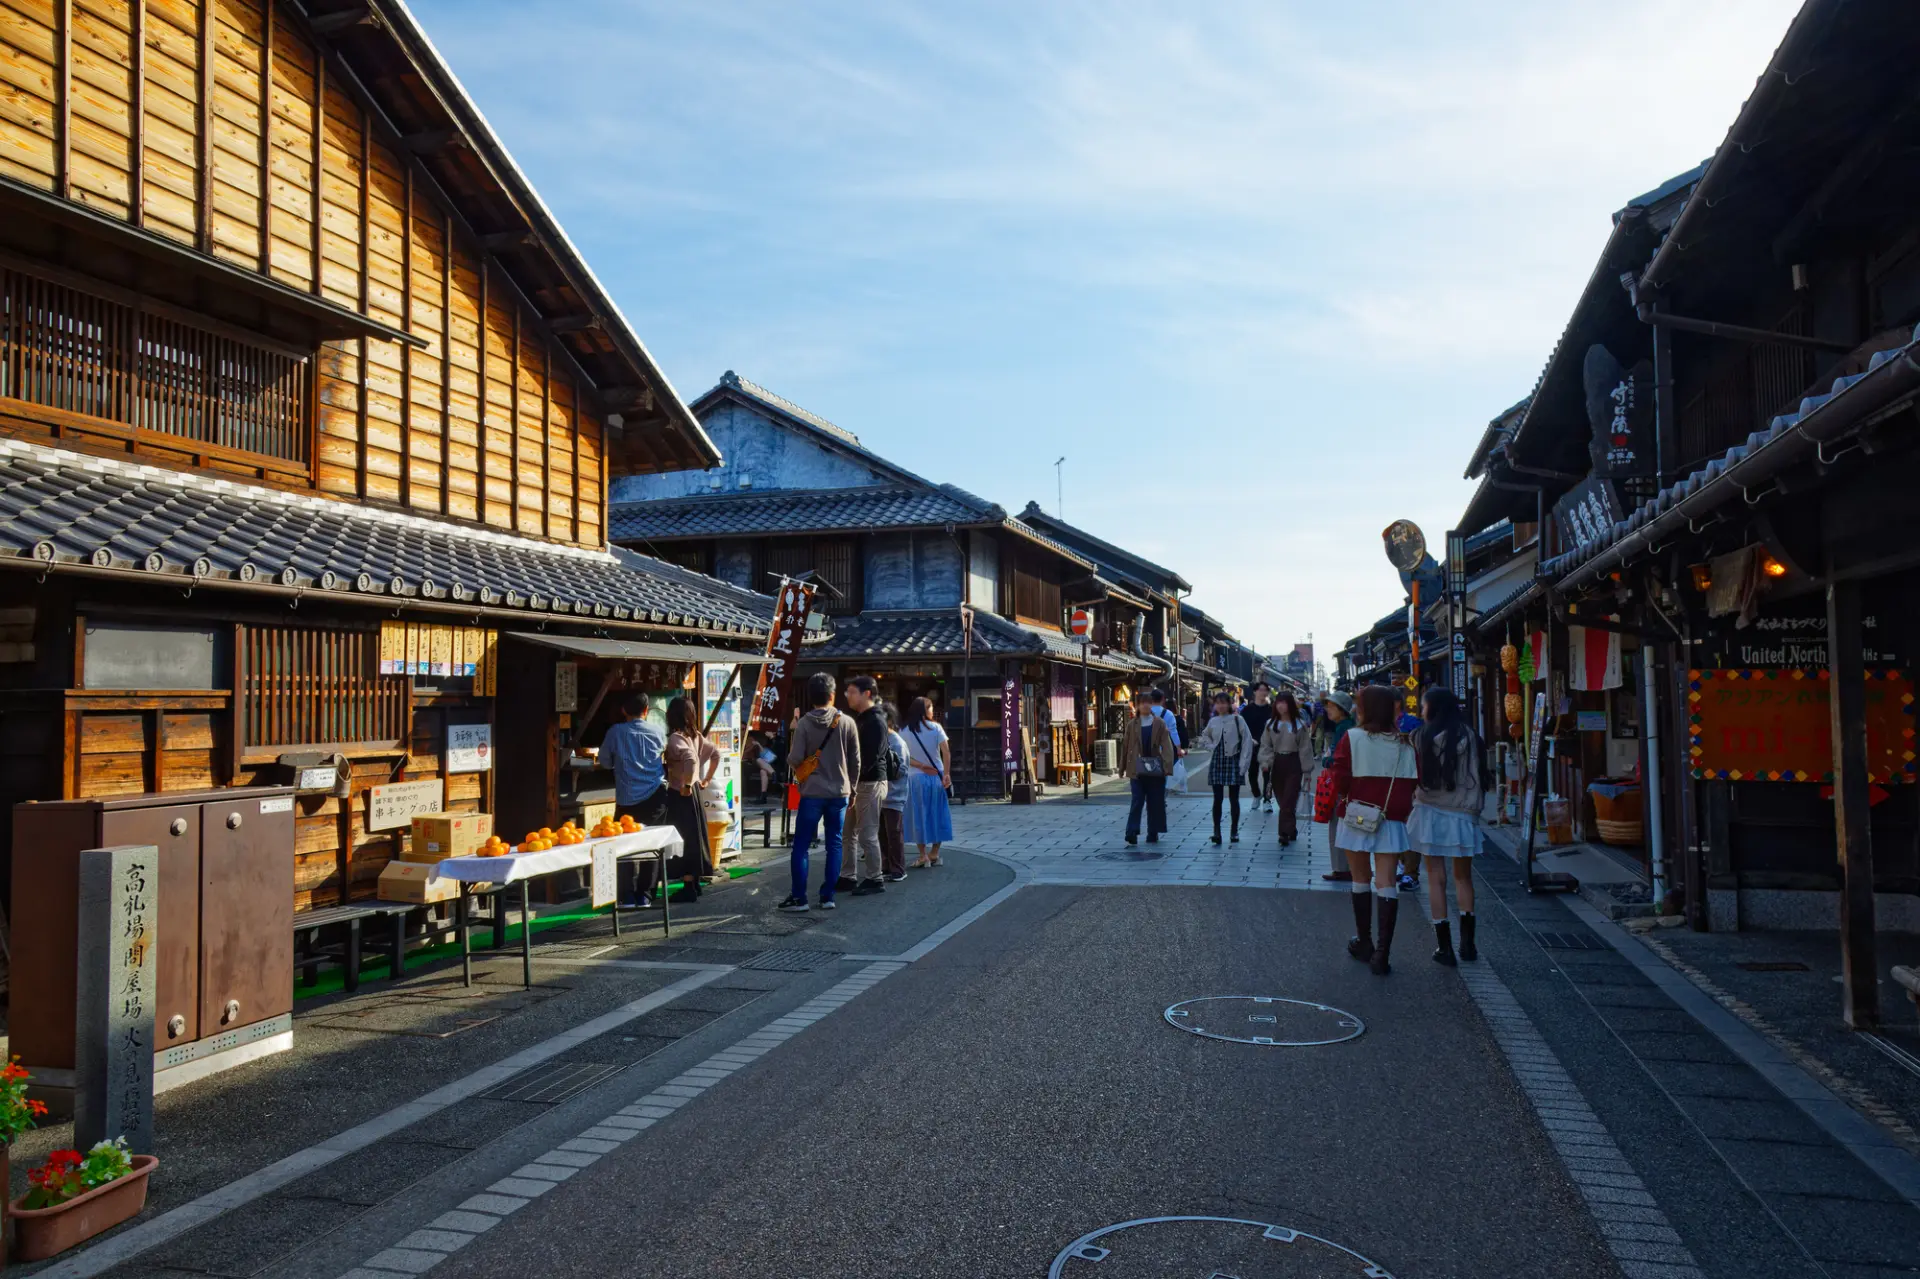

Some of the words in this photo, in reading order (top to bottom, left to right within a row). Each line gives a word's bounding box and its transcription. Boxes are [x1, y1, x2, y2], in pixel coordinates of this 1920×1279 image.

[1741, 644, 1786, 664] United
[1788, 644, 1828, 664] North
[631, 663, 678, 685] 五平餅
[375, 800, 439, 820] 串キングの店
